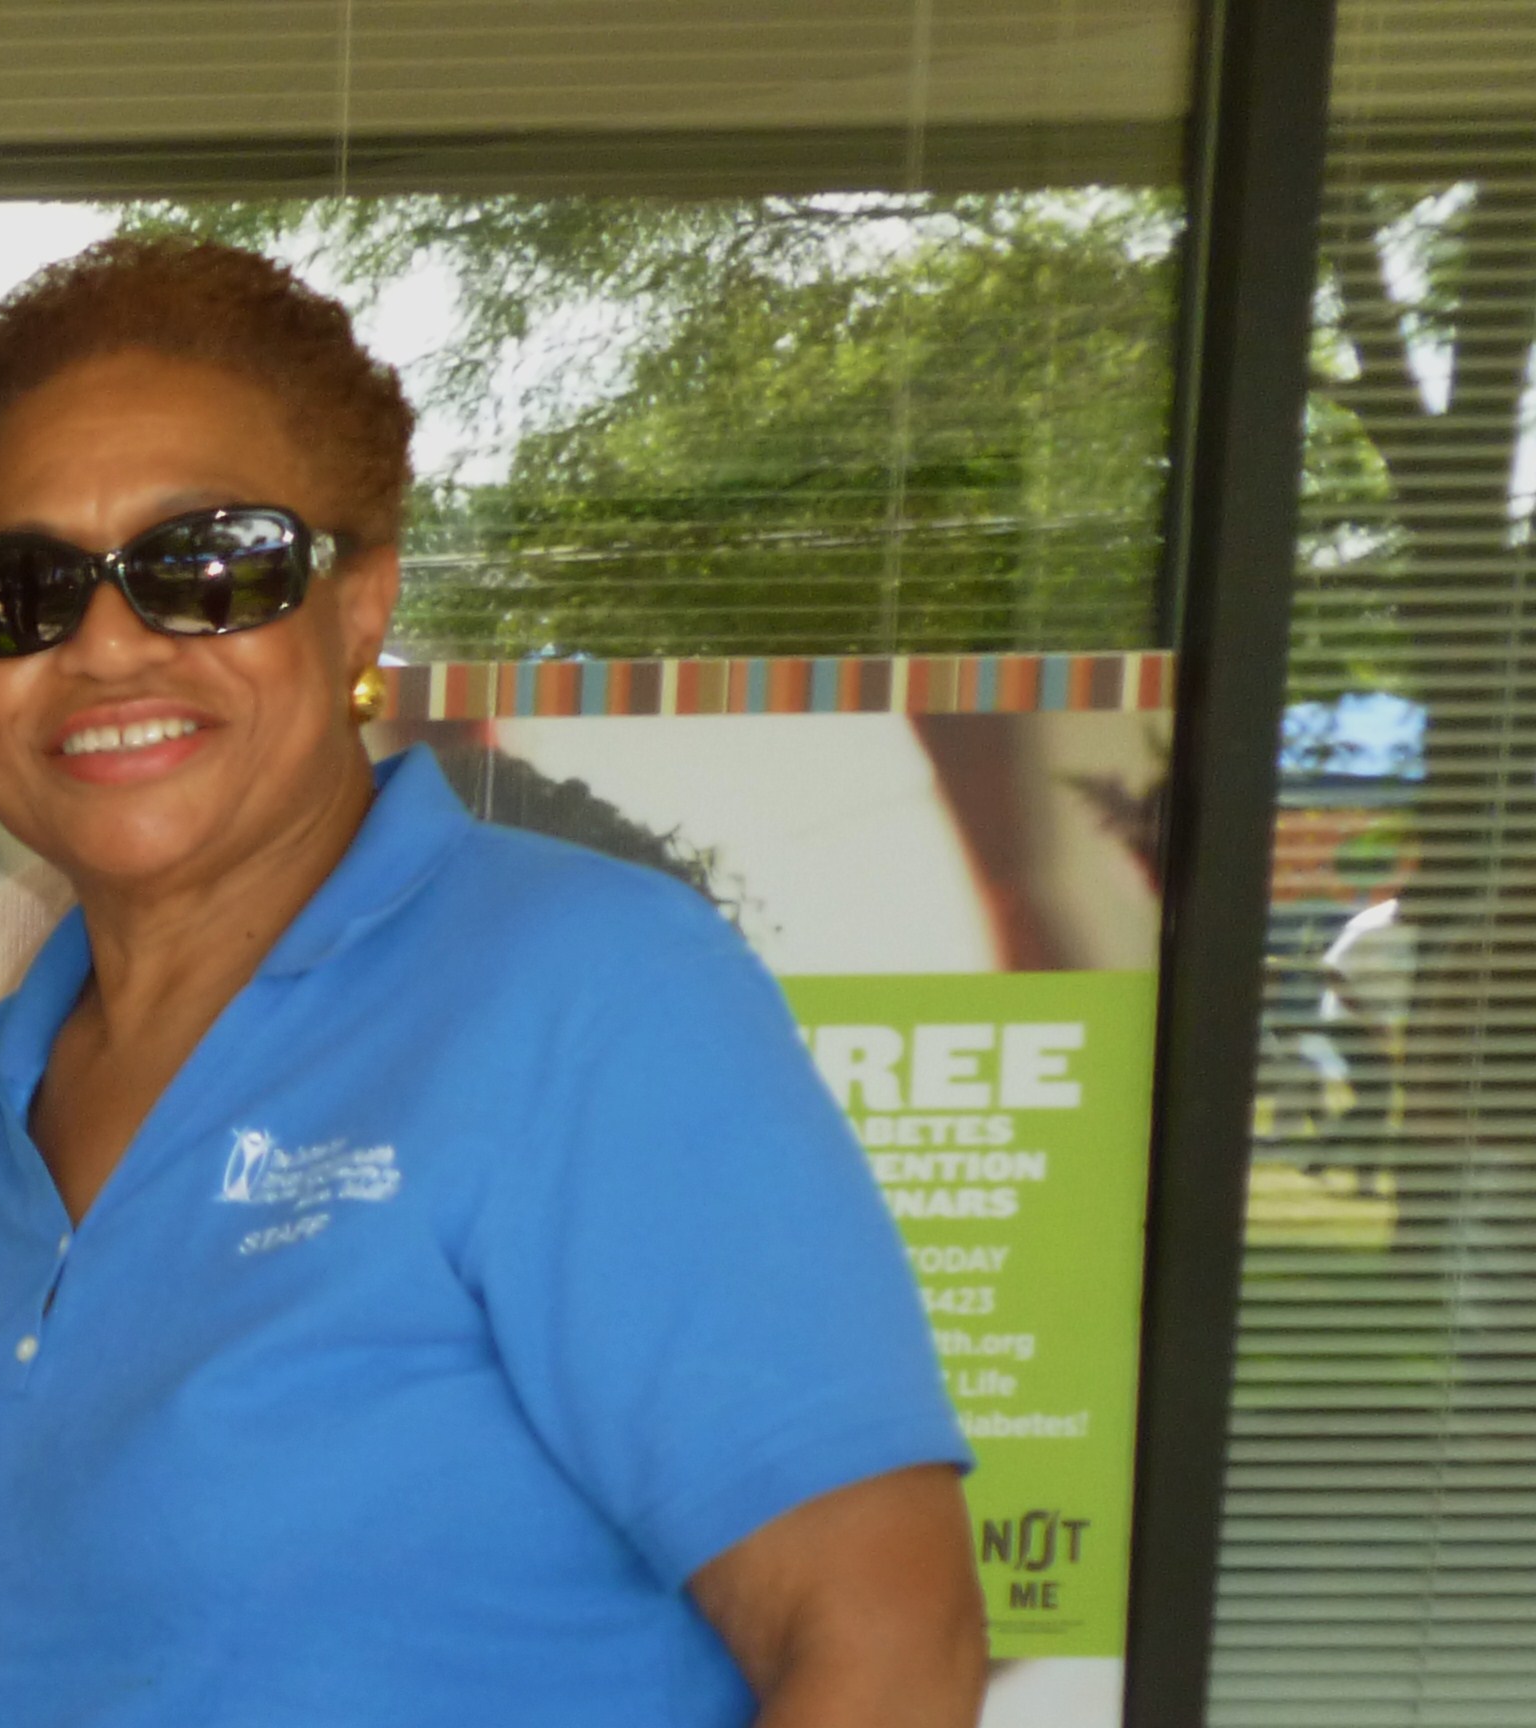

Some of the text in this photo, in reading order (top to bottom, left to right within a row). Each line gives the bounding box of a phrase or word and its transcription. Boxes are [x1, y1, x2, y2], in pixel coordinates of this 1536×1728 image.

[797, 1022, 1084, 1110] REE
[957, 1369, 1018, 1397] Life
[962, 1409, 1090, 1438] iabetes!
[982, 1508, 1090, 1572] NOT
[1009, 1582, 1059, 1609] ME
